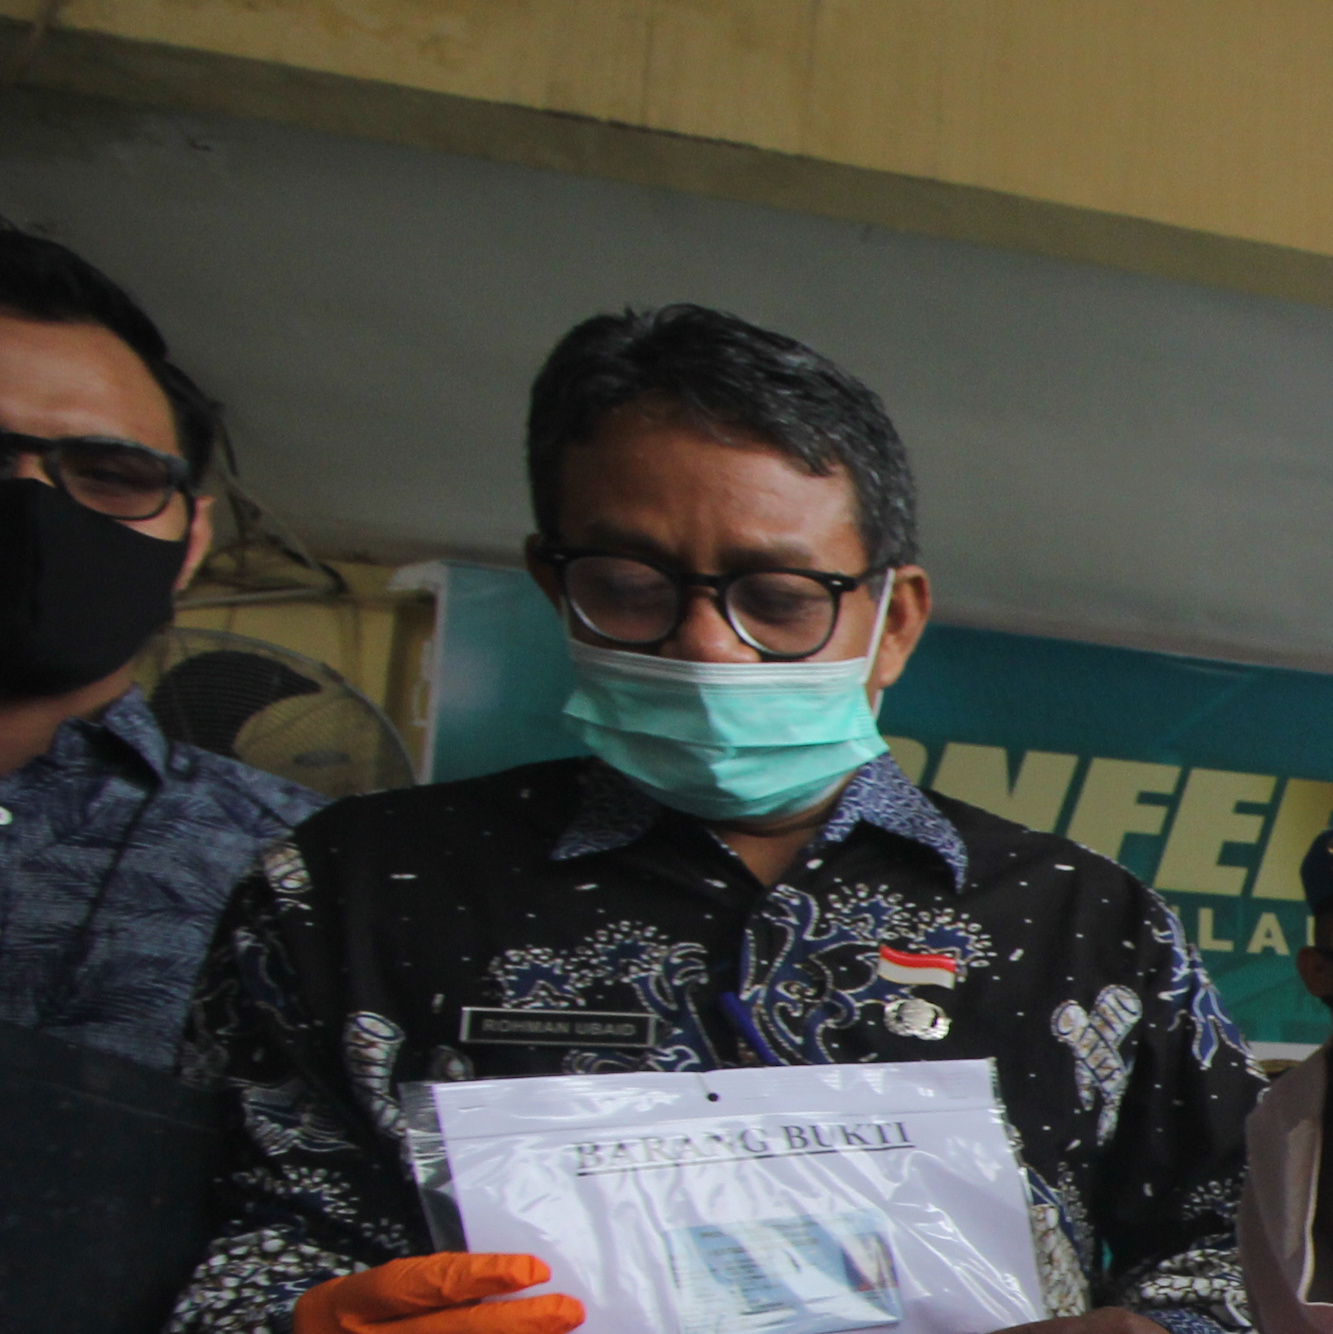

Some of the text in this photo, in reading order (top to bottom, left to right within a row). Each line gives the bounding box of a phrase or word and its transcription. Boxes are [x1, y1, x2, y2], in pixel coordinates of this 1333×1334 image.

[1172, 905, 1315, 956] LA
[577, 1121, 912, 1171] BARANG BUKTI
